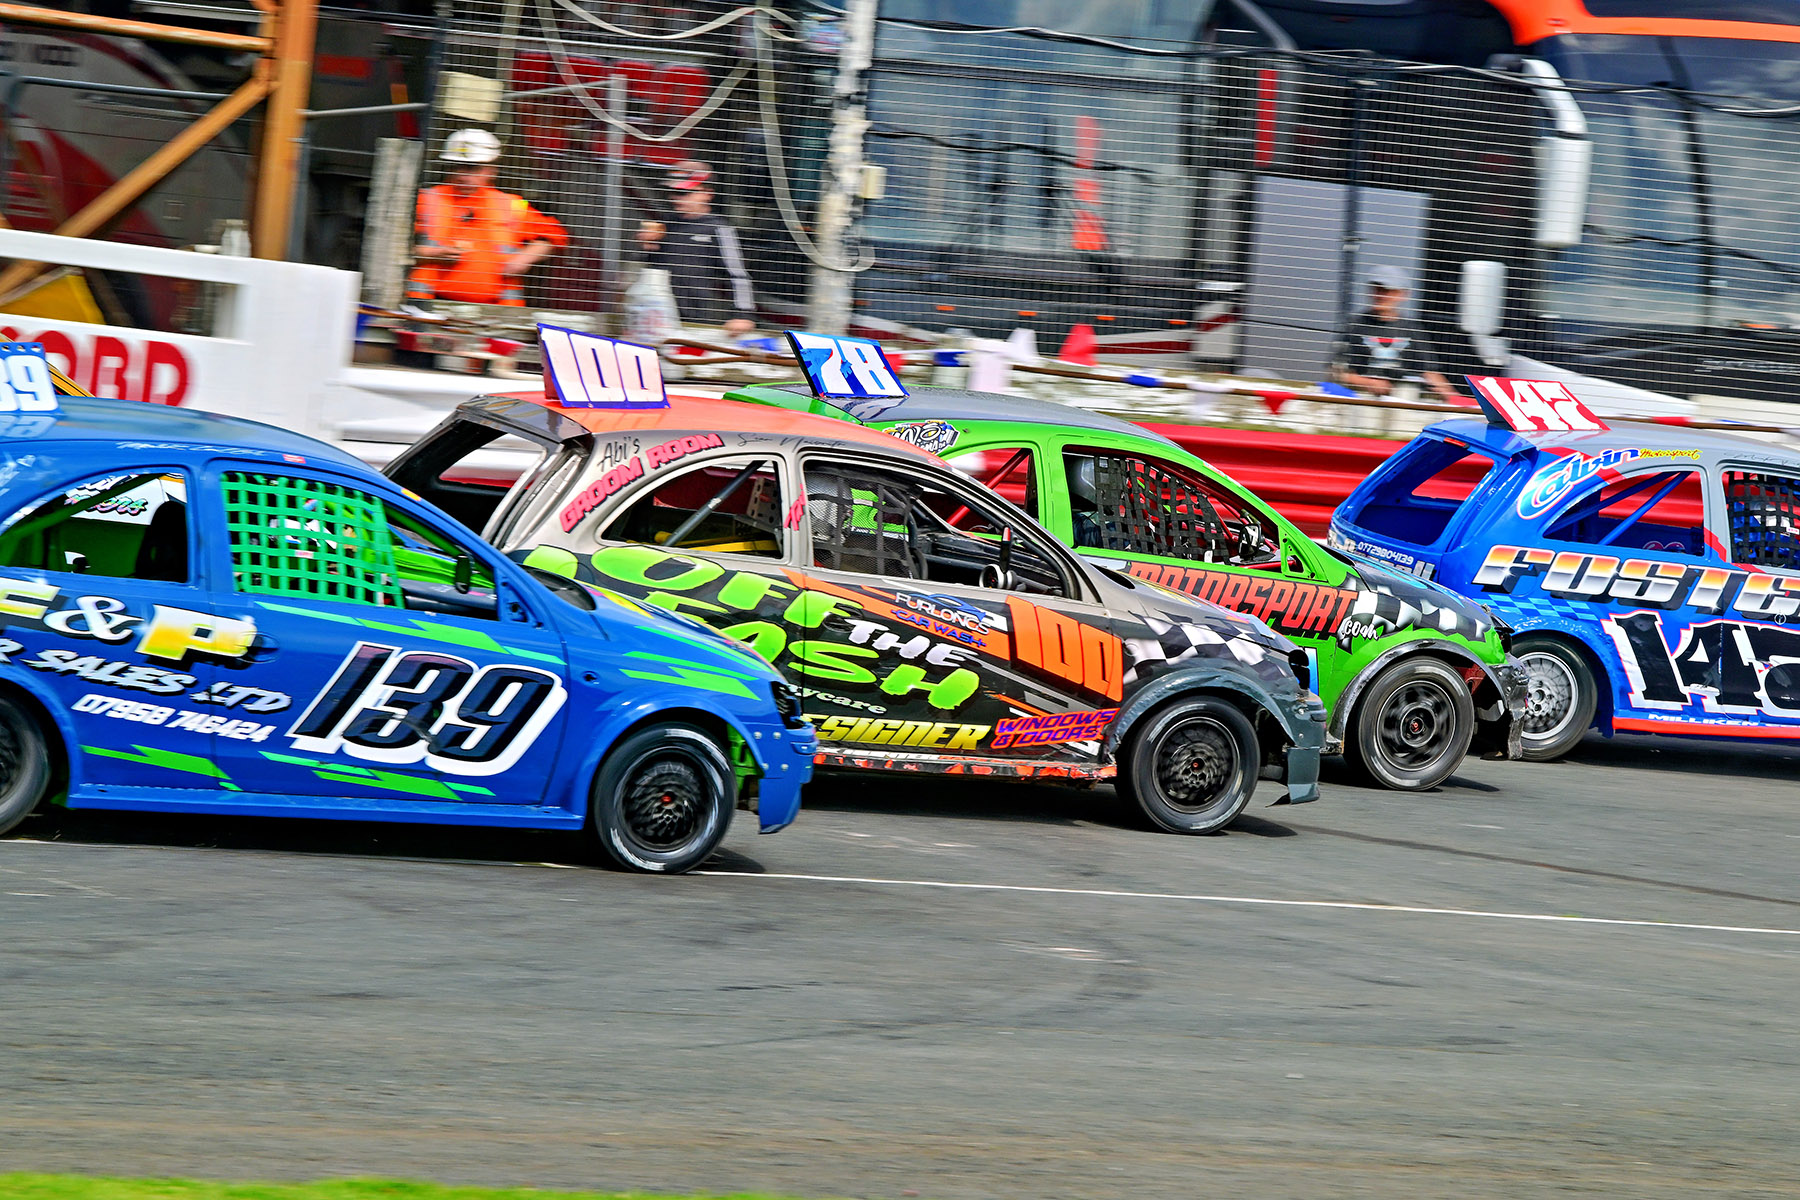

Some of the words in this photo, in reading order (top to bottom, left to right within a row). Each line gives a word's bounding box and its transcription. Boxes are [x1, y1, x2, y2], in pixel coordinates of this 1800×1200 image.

[0, 325, 192, 407] ORD
[541, 328, 667, 403] 100
[793, 331, 907, 398] 78
[1477, 376, 1601, 431] 147
[559, 456, 645, 533] GROOM
[646, 433, 726, 469] ROOM
[1517, 447, 1641, 520] Calvin
[44, 595, 144, 641] &
[135, 604, 258, 661] P
[591, 545, 864, 629] OFF
[844, 618, 979, 668] THE
[895, 592, 992, 635] FURLONGS
[21, 649, 197, 694] SALES
[189, 681, 292, 713] LTD
[1005, 594, 1123, 703] 100
[71, 693, 176, 726] 07958
[165, 710, 278, 743] 746424
[286, 641, 568, 777] 139
[996, 710, 1118, 733] WINDOWS
[1016, 725, 1101, 744] DOORS
